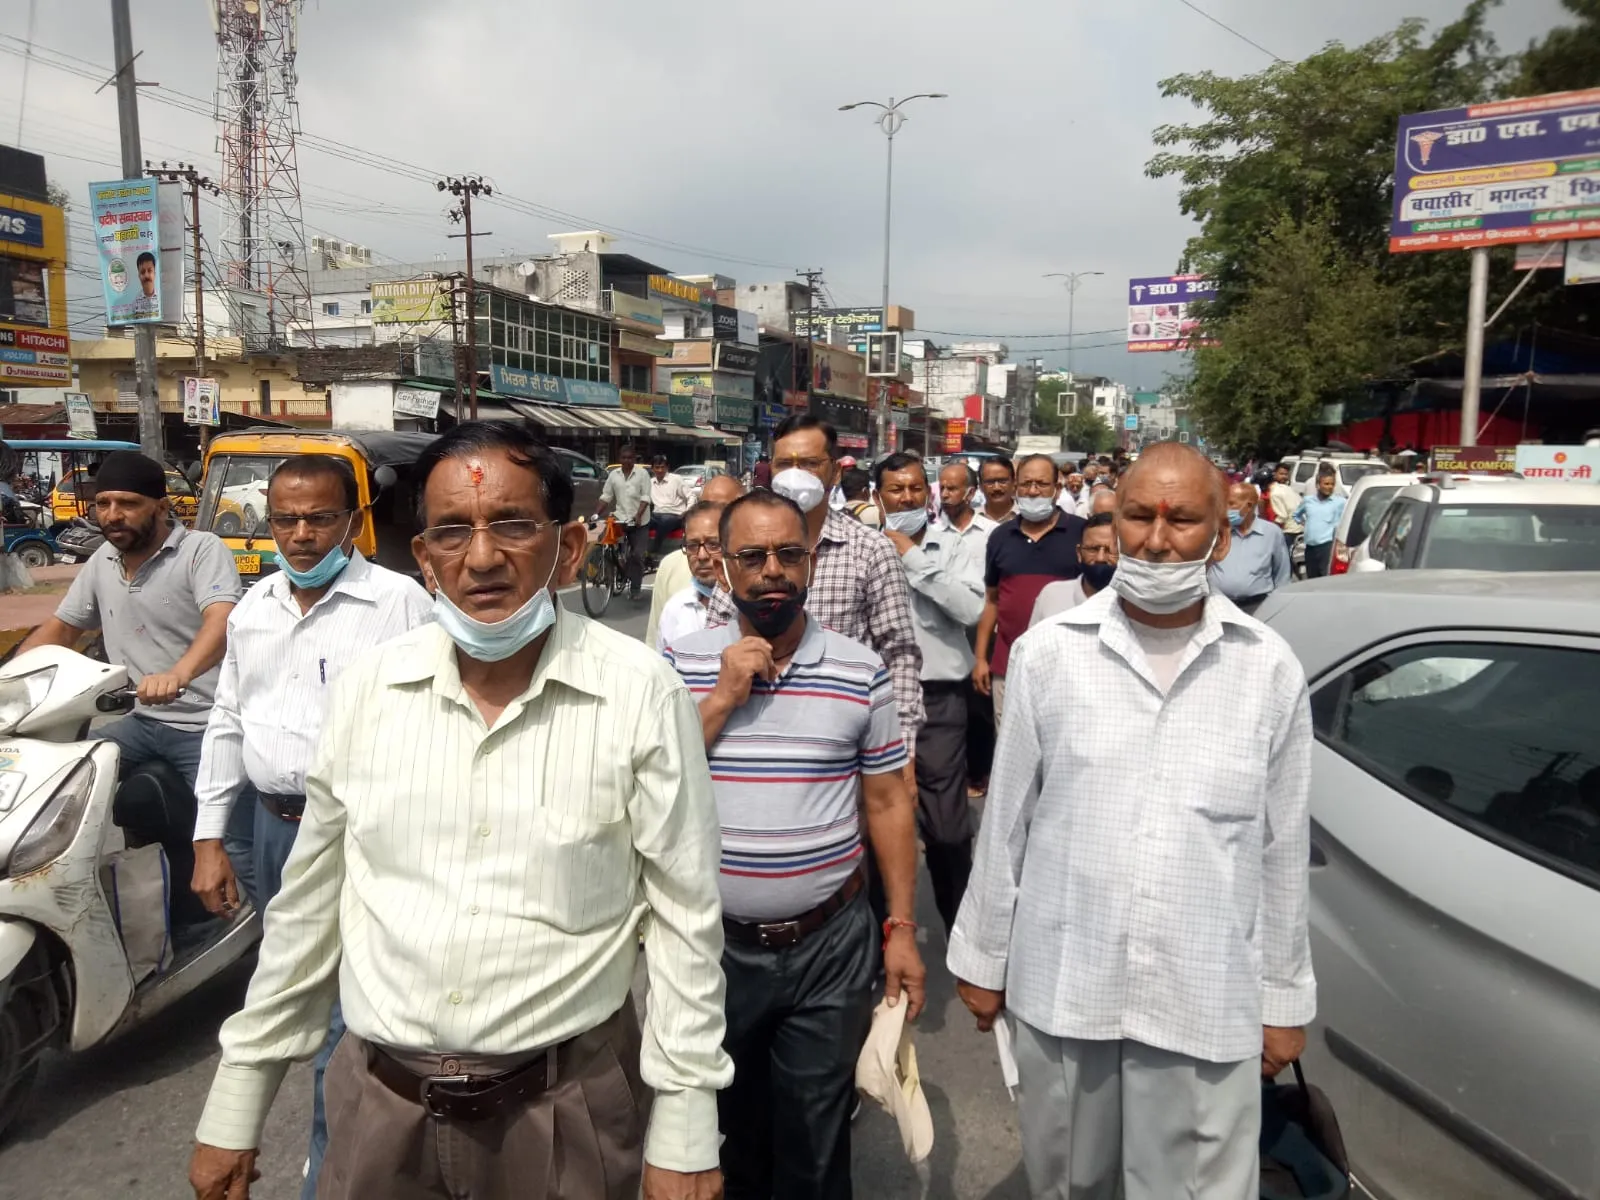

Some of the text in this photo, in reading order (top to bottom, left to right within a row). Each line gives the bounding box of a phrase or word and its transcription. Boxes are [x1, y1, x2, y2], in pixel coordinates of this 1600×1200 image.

[1410, 190, 1474, 211] बवासीर
[21, 333, 66, 349] HITACHI
[1436, 460, 1468, 470] REGAL
[1523, 464, 1592, 479] बाबा जी
